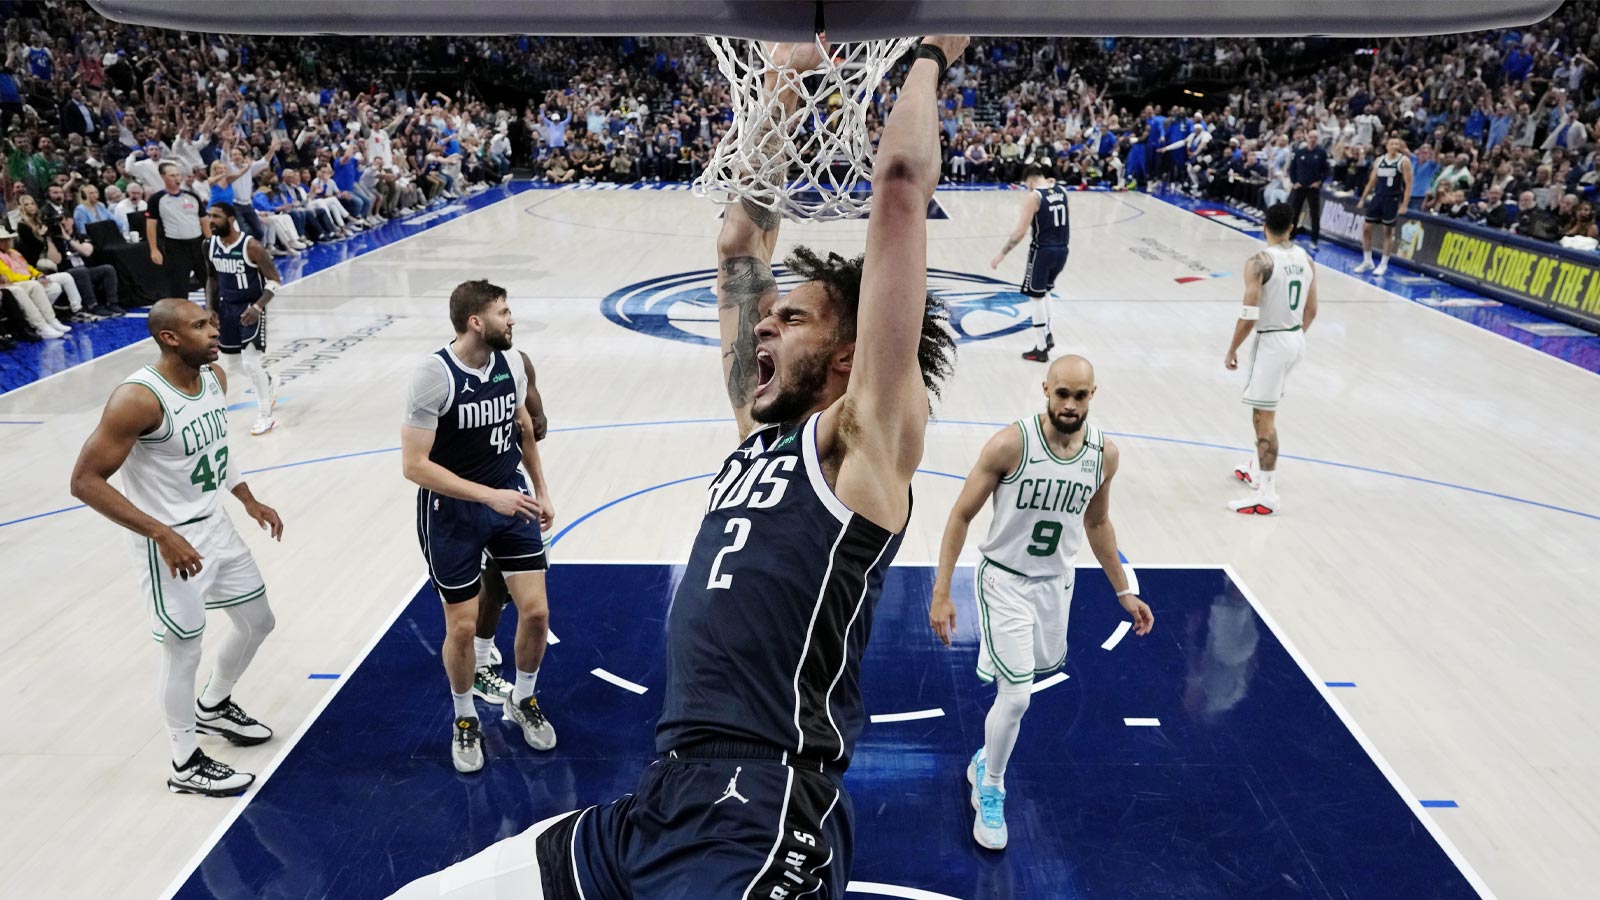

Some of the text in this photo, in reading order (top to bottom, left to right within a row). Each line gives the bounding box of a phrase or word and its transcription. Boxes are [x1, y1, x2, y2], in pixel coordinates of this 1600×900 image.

[1049, 204, 1066, 227] 77
[235, 273, 249, 289] 11
[1437, 231, 1492, 279] OFFICIAL
[1486, 245, 1538, 293] STORE
[1529, 257, 1558, 297] OF
[1551, 262, 1591, 308] THE
[1289, 280, 1302, 310] 0
[260, 337, 327, 370] Cente
[490, 422, 513, 454] 42
[190, 445, 229, 492] 42
[1016, 478, 1092, 515] CELTICS
[706, 517, 751, 589] 2
[1027, 520, 1063, 557] 9
